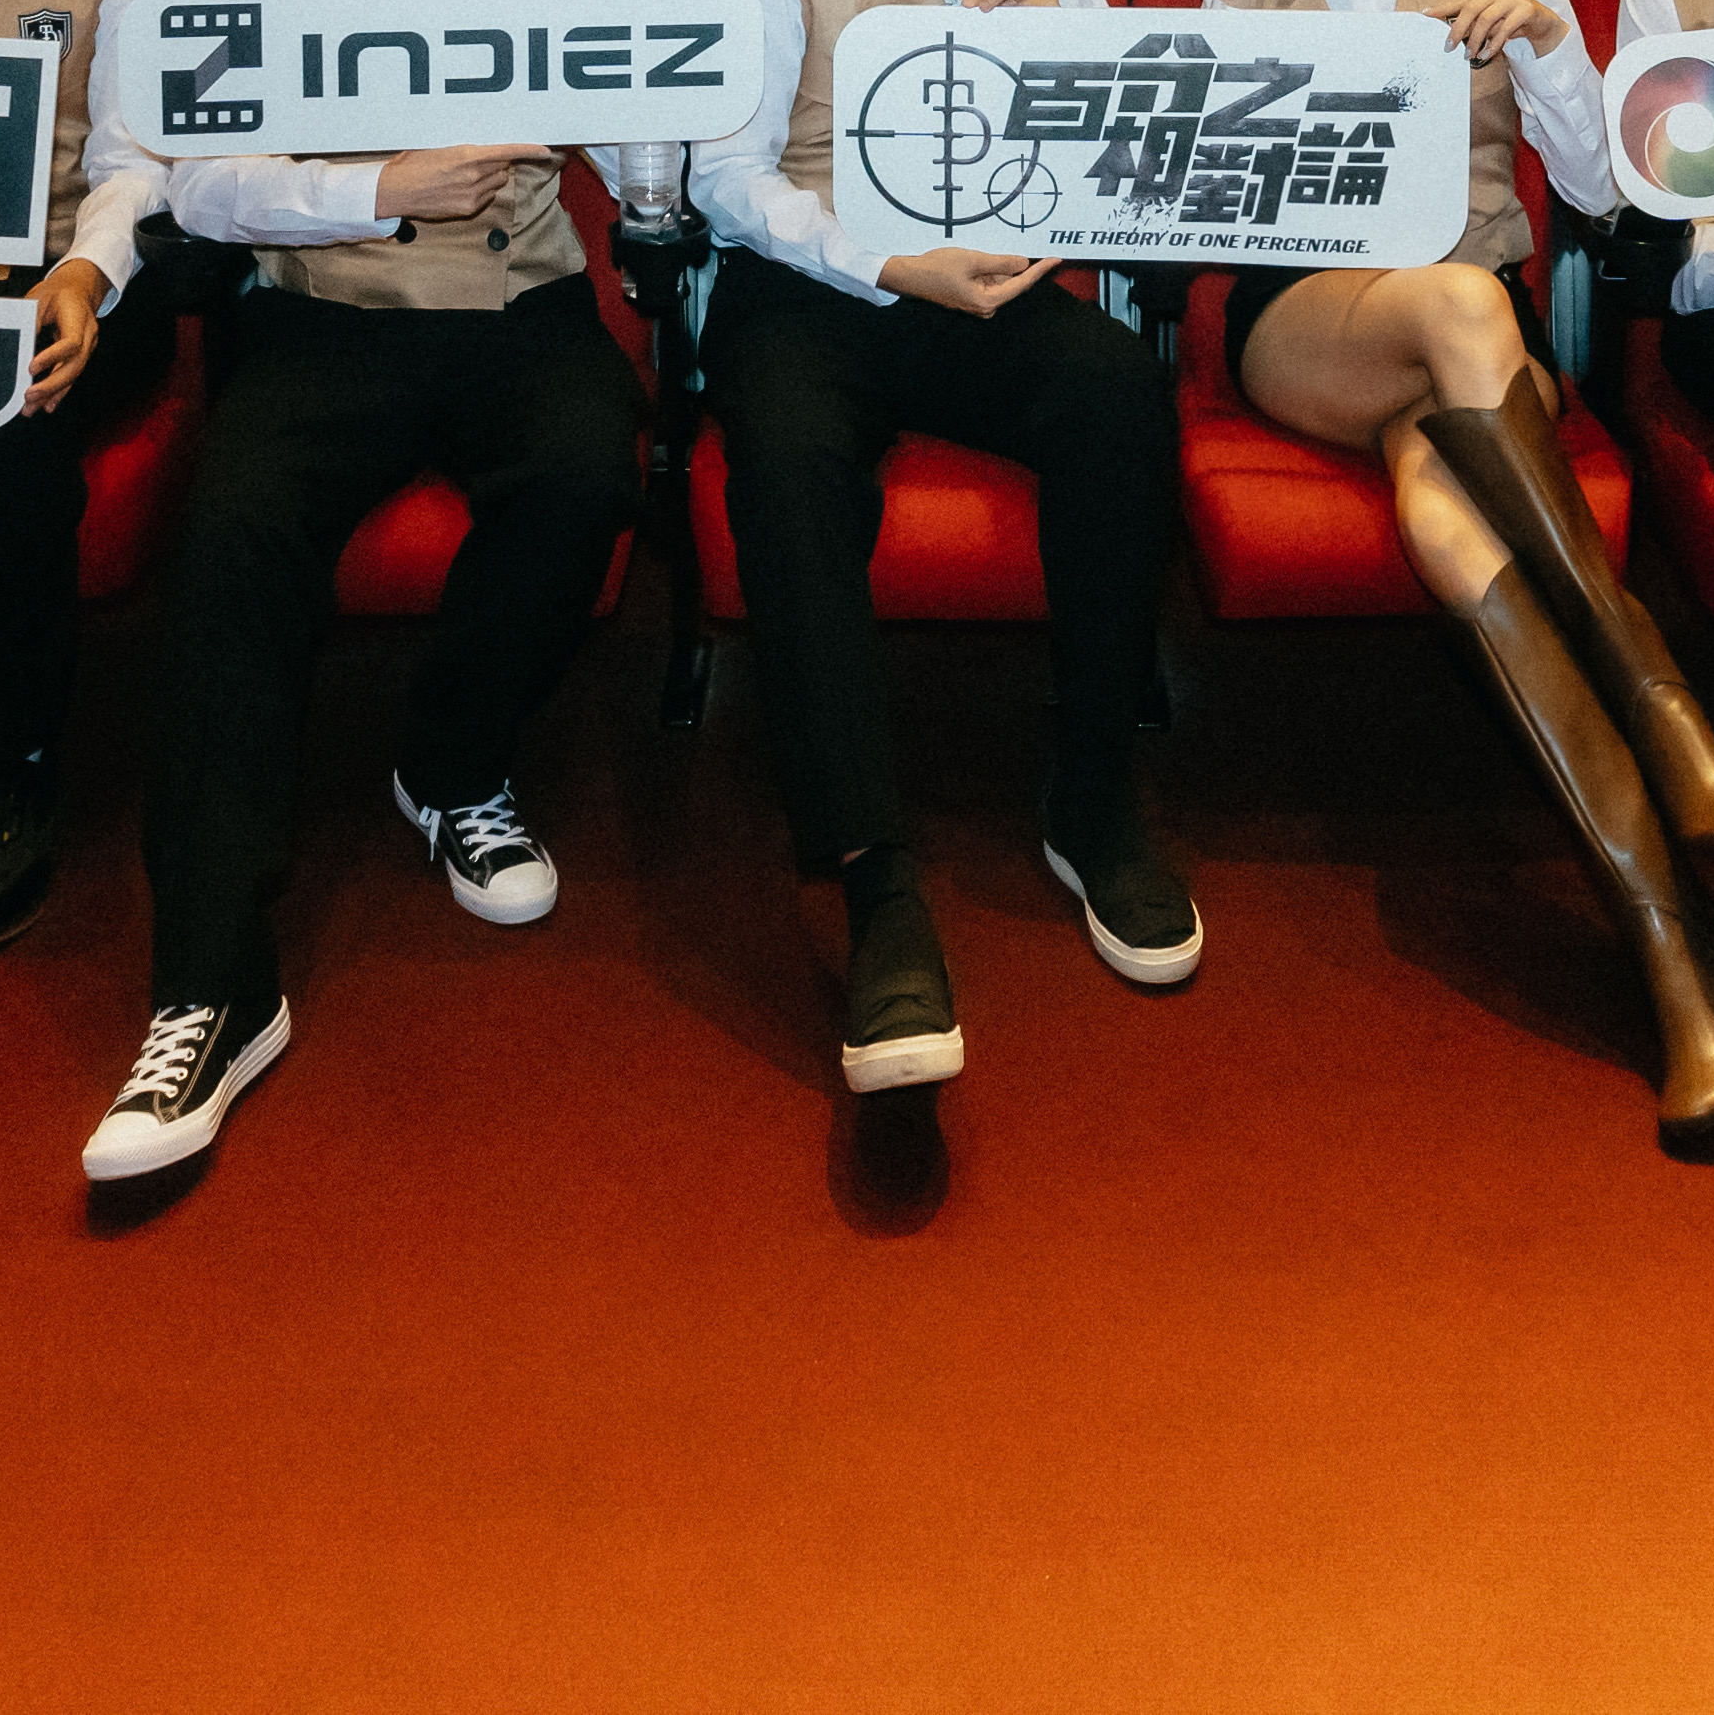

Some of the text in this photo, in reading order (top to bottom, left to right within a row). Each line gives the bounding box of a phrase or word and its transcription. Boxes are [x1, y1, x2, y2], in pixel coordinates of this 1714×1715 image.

[303, 23, 726, 98] INDIEZ
[1002, 32, 1411, 142] 百分之一
[1084, 115, 1396, 226] 相對論
[1048, 230, 1371, 255] THE THEORY OF ONE PERCENTAGE.
